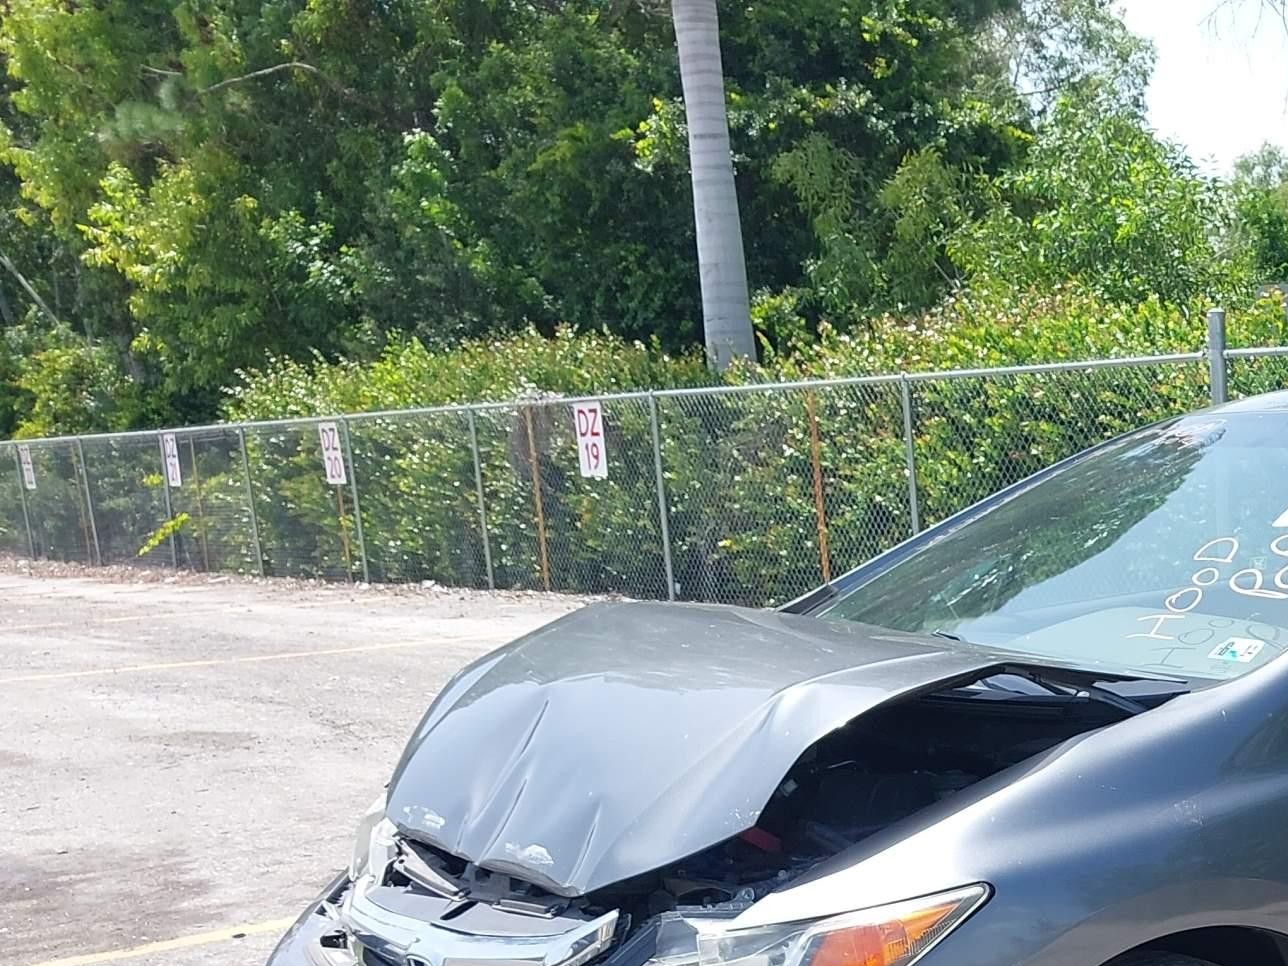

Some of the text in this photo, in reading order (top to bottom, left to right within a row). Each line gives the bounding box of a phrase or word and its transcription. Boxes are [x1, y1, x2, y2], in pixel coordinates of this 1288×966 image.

[577, 408, 600, 437] DZ
[321, 427, 339, 451] DZ
[327, 456, 342, 478] 20
[584, 442, 600, 470] 19
